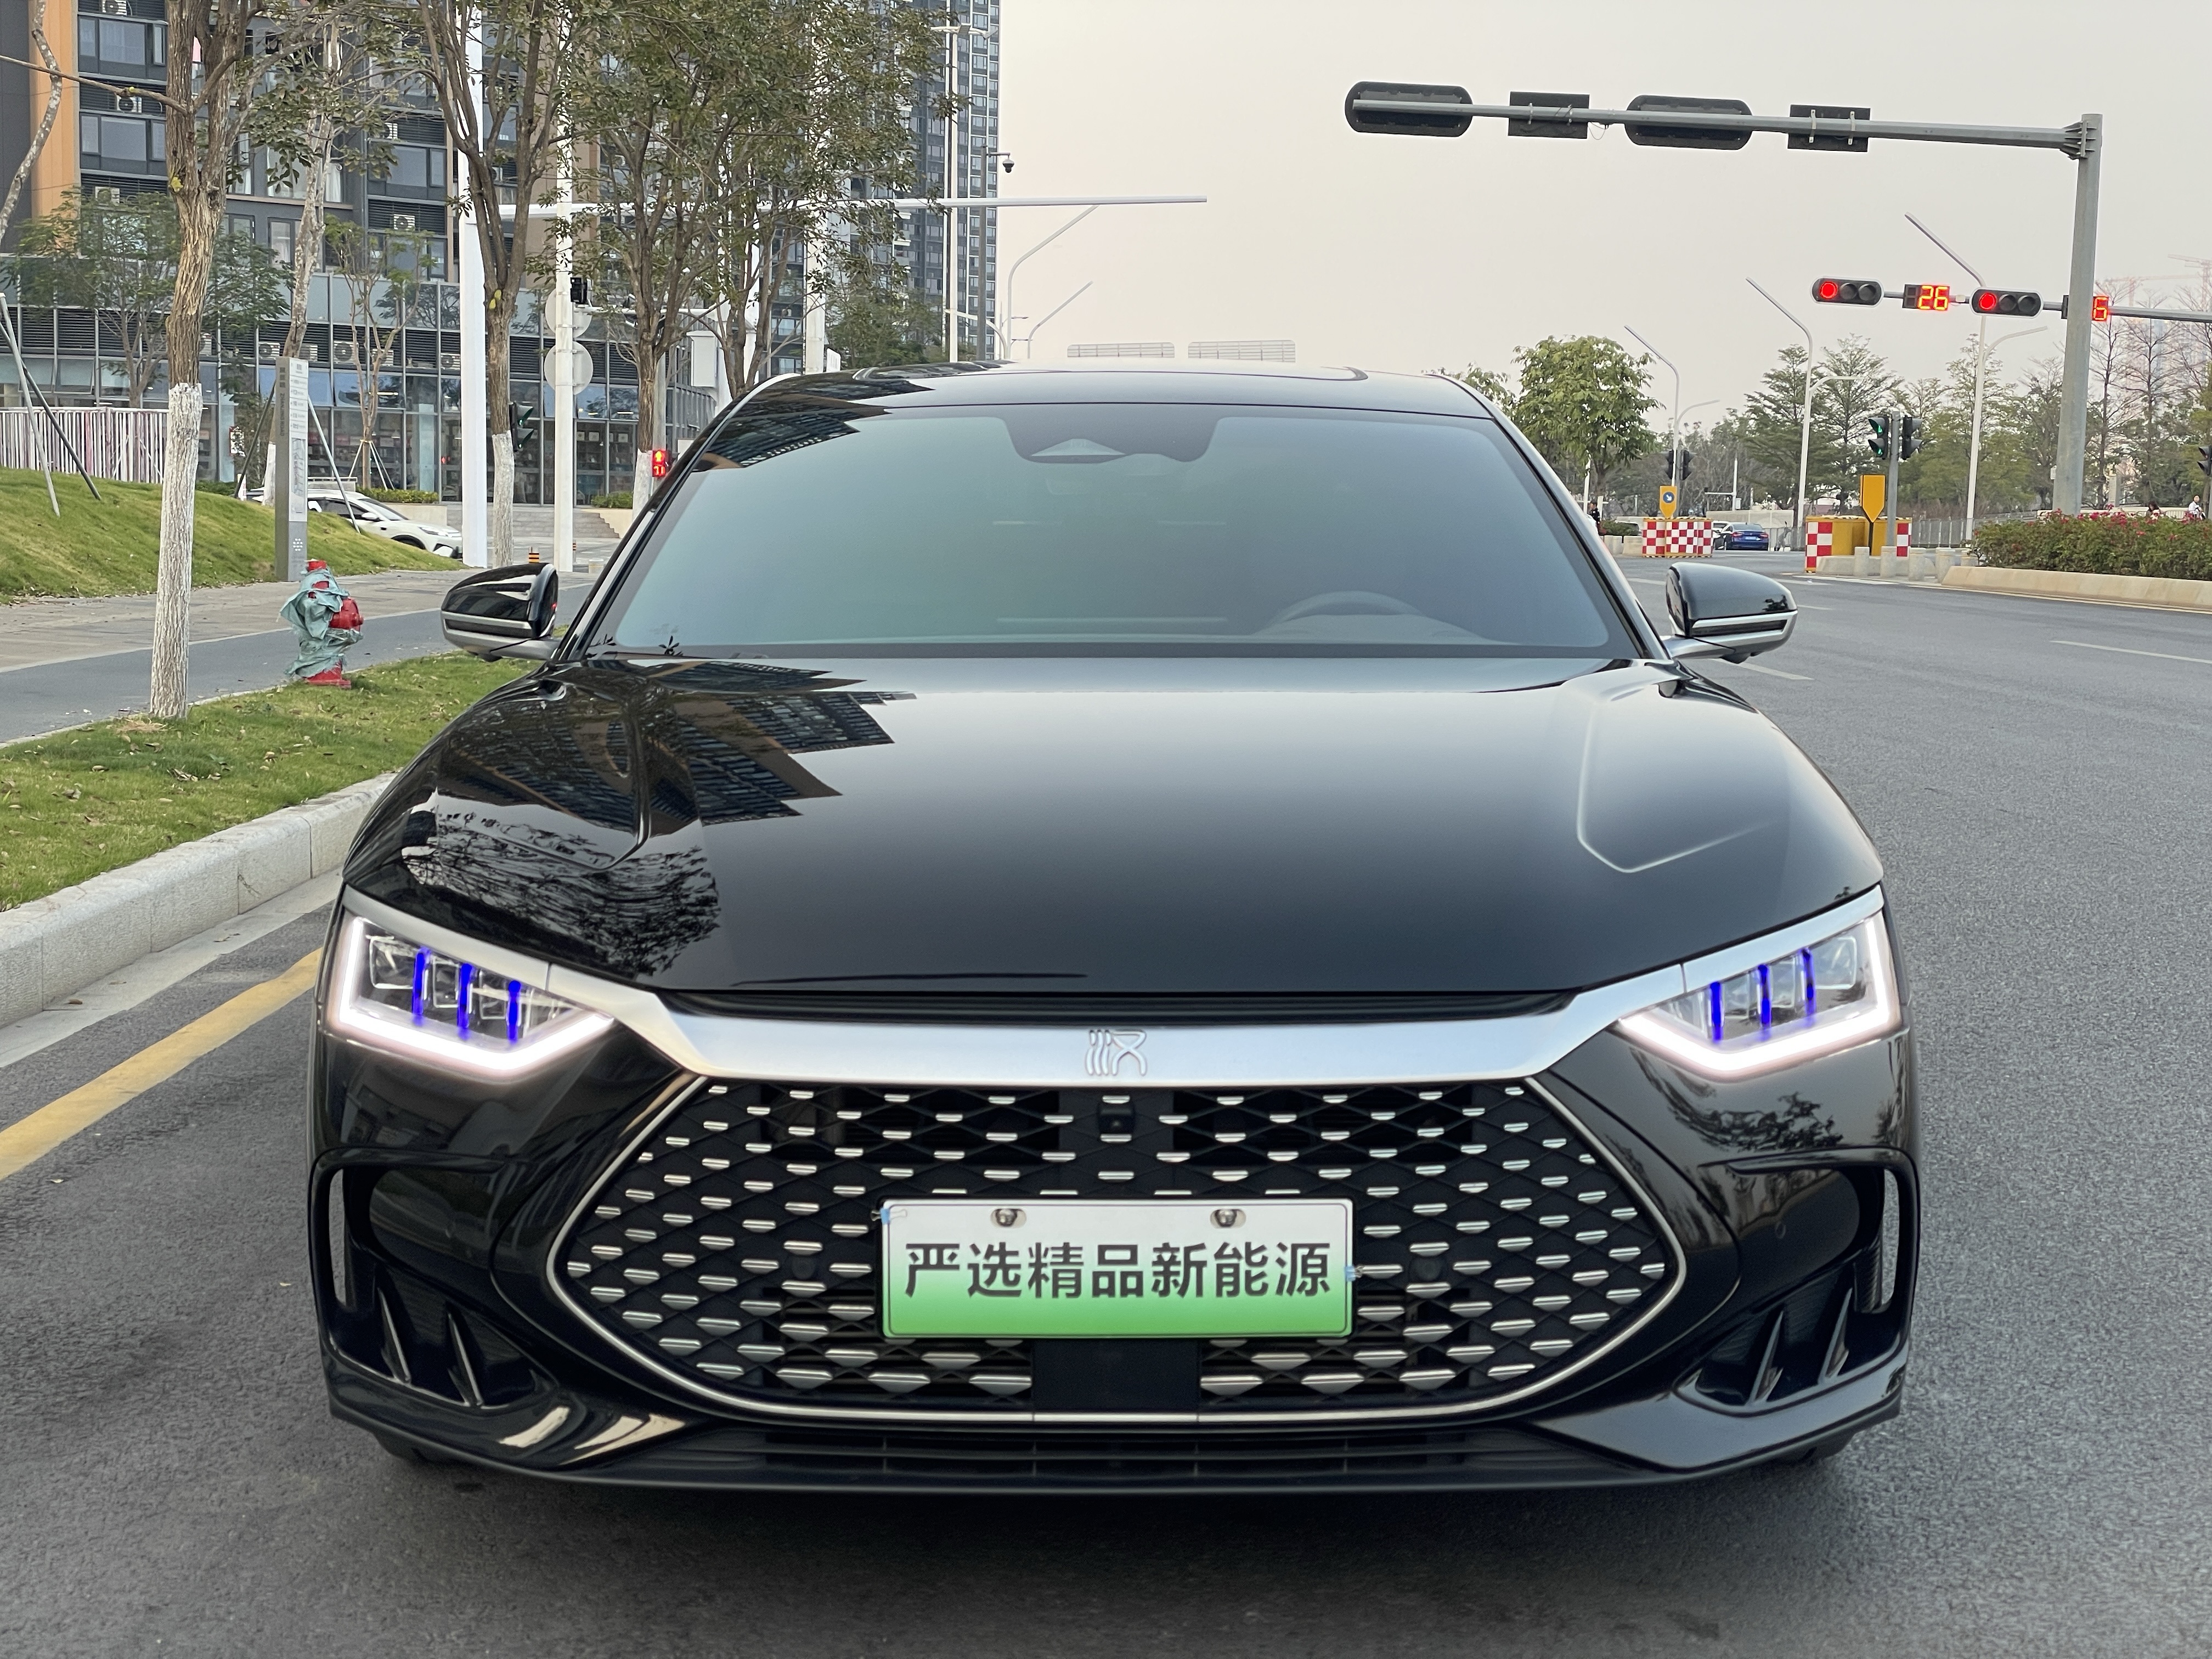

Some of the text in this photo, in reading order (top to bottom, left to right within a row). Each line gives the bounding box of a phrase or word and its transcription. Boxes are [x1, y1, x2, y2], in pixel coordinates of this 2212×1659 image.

[1918, 285, 1948, 311] 26
[905, 1242, 1330, 1299] 严选精品新能源
